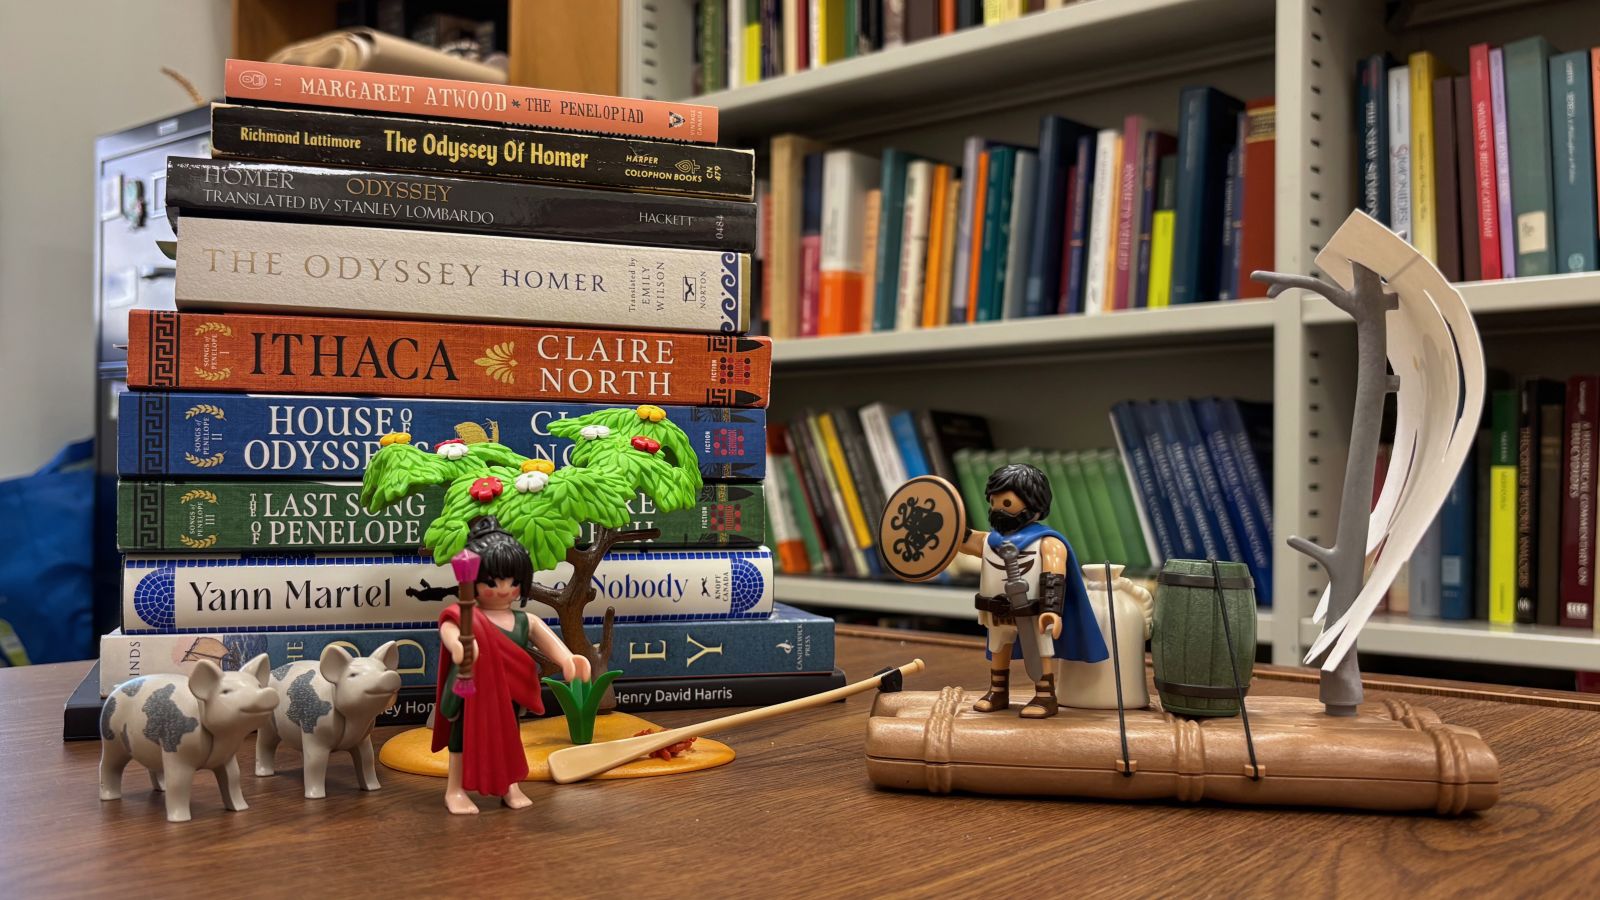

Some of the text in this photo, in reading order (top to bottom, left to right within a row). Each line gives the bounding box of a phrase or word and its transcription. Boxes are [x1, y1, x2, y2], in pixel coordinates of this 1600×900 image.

[300, 77, 644, 124] MARGARET ATWOOD THE PENELOPIAD
[240, 127, 361, 149] Richmond Lattimore
[384, 129, 589, 169] The Odyssey Of Homer
[625, 154, 659, 165] HARPER
[706, 166, 713, 179] CN
[203, 167, 295, 190] HOMER
[625, 168, 702, 183] COLOPHON BOOKS
[714, 165, 722, 182] 479
[346, 177, 452, 202] ODYSSEY
[203, 188, 494, 225] TRANSLATED BY STANLEY LOMBARDO
[639, 211, 695, 227] HACKETT
[202, 248, 482, 288] THE ODYSSEY
[501, 268, 607, 293] HOMER
[628, 257, 639, 313] Translated by
[642, 266, 650, 305] EMILY
[656, 261, 665, 312] WILSON
[250, 332, 460, 381] ITHACA
[537, 335, 675, 365] CLAIRE
[539, 367, 672, 397] NORTH
[268, 405, 395, 437] HOUSE
[211, 433, 223, 441] II
[264, 493, 337, 518] LAST
[205, 514, 216, 525] III
[251, 521, 422, 545] OF PENELOPE
[189, 578, 392, 612] Yann Martel
[591, 572, 689, 603] Nobody
[129, 641, 141, 676] INDS
[655, 687, 691, 703] David
[695, 686, 733, 701] Harris
